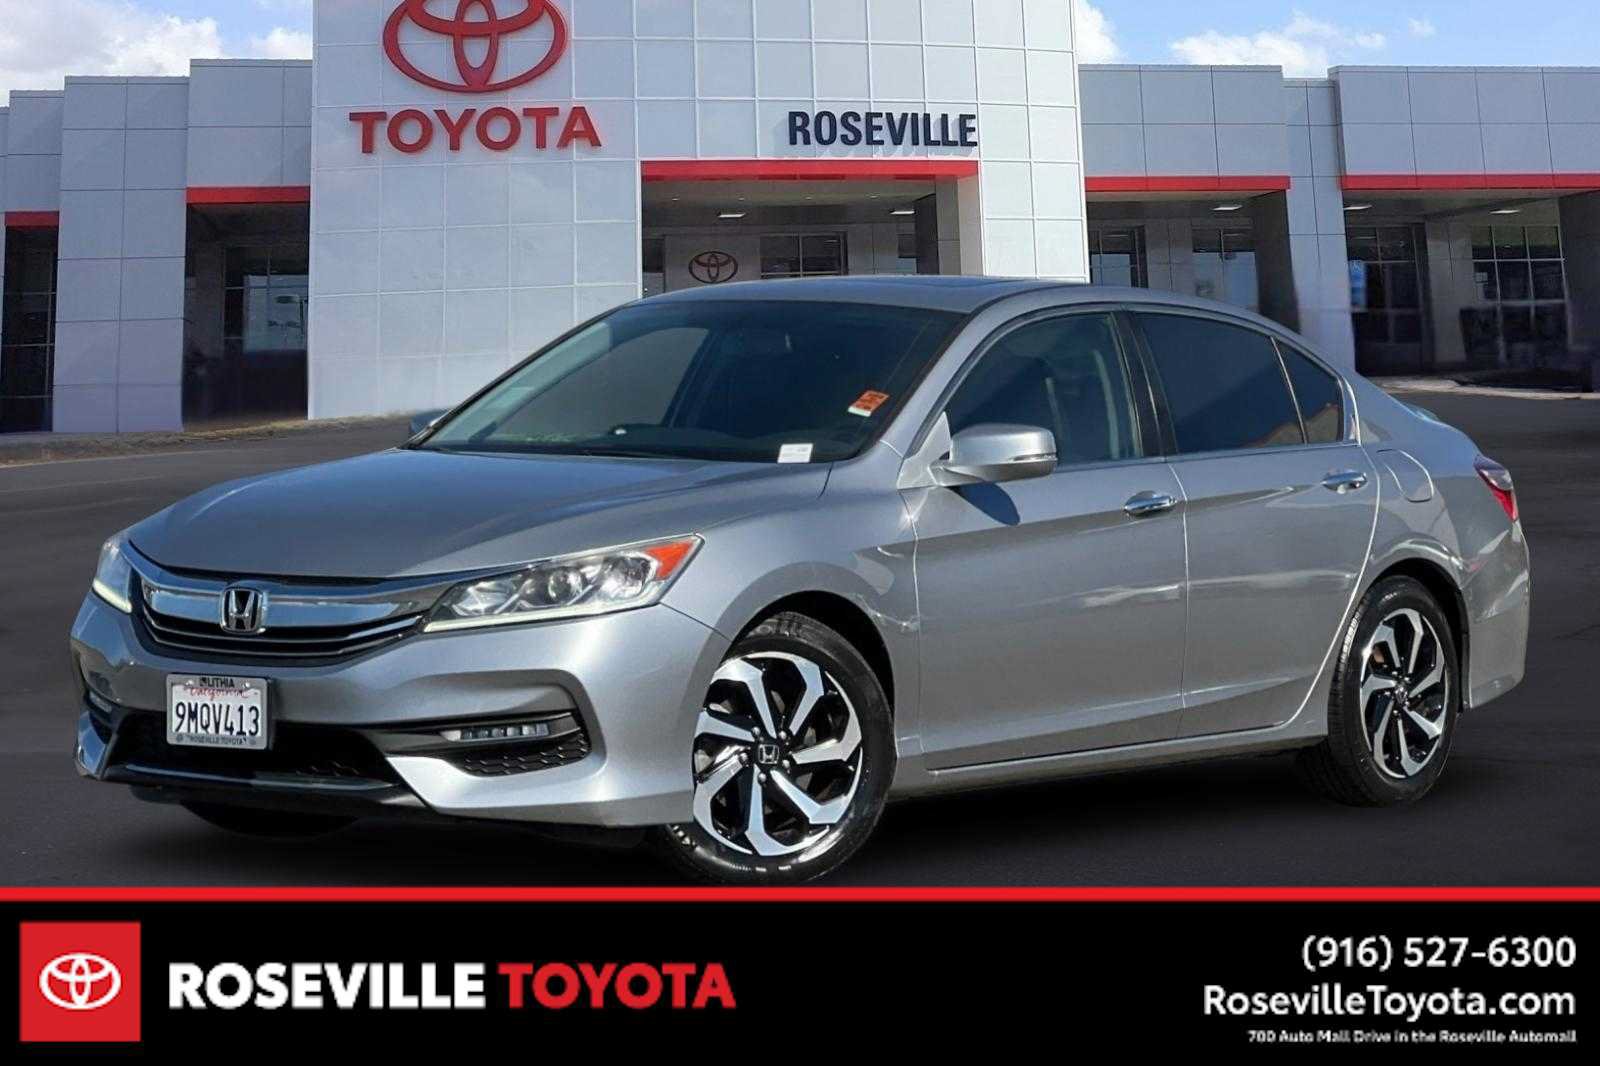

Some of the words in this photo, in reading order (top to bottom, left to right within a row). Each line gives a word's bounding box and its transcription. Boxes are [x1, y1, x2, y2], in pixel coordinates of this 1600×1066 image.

[349, 106, 602, 154] TOYOTA
[789, 111, 978, 147] ROSEVILLE
[175, 701, 260, 737] 9MQV413
